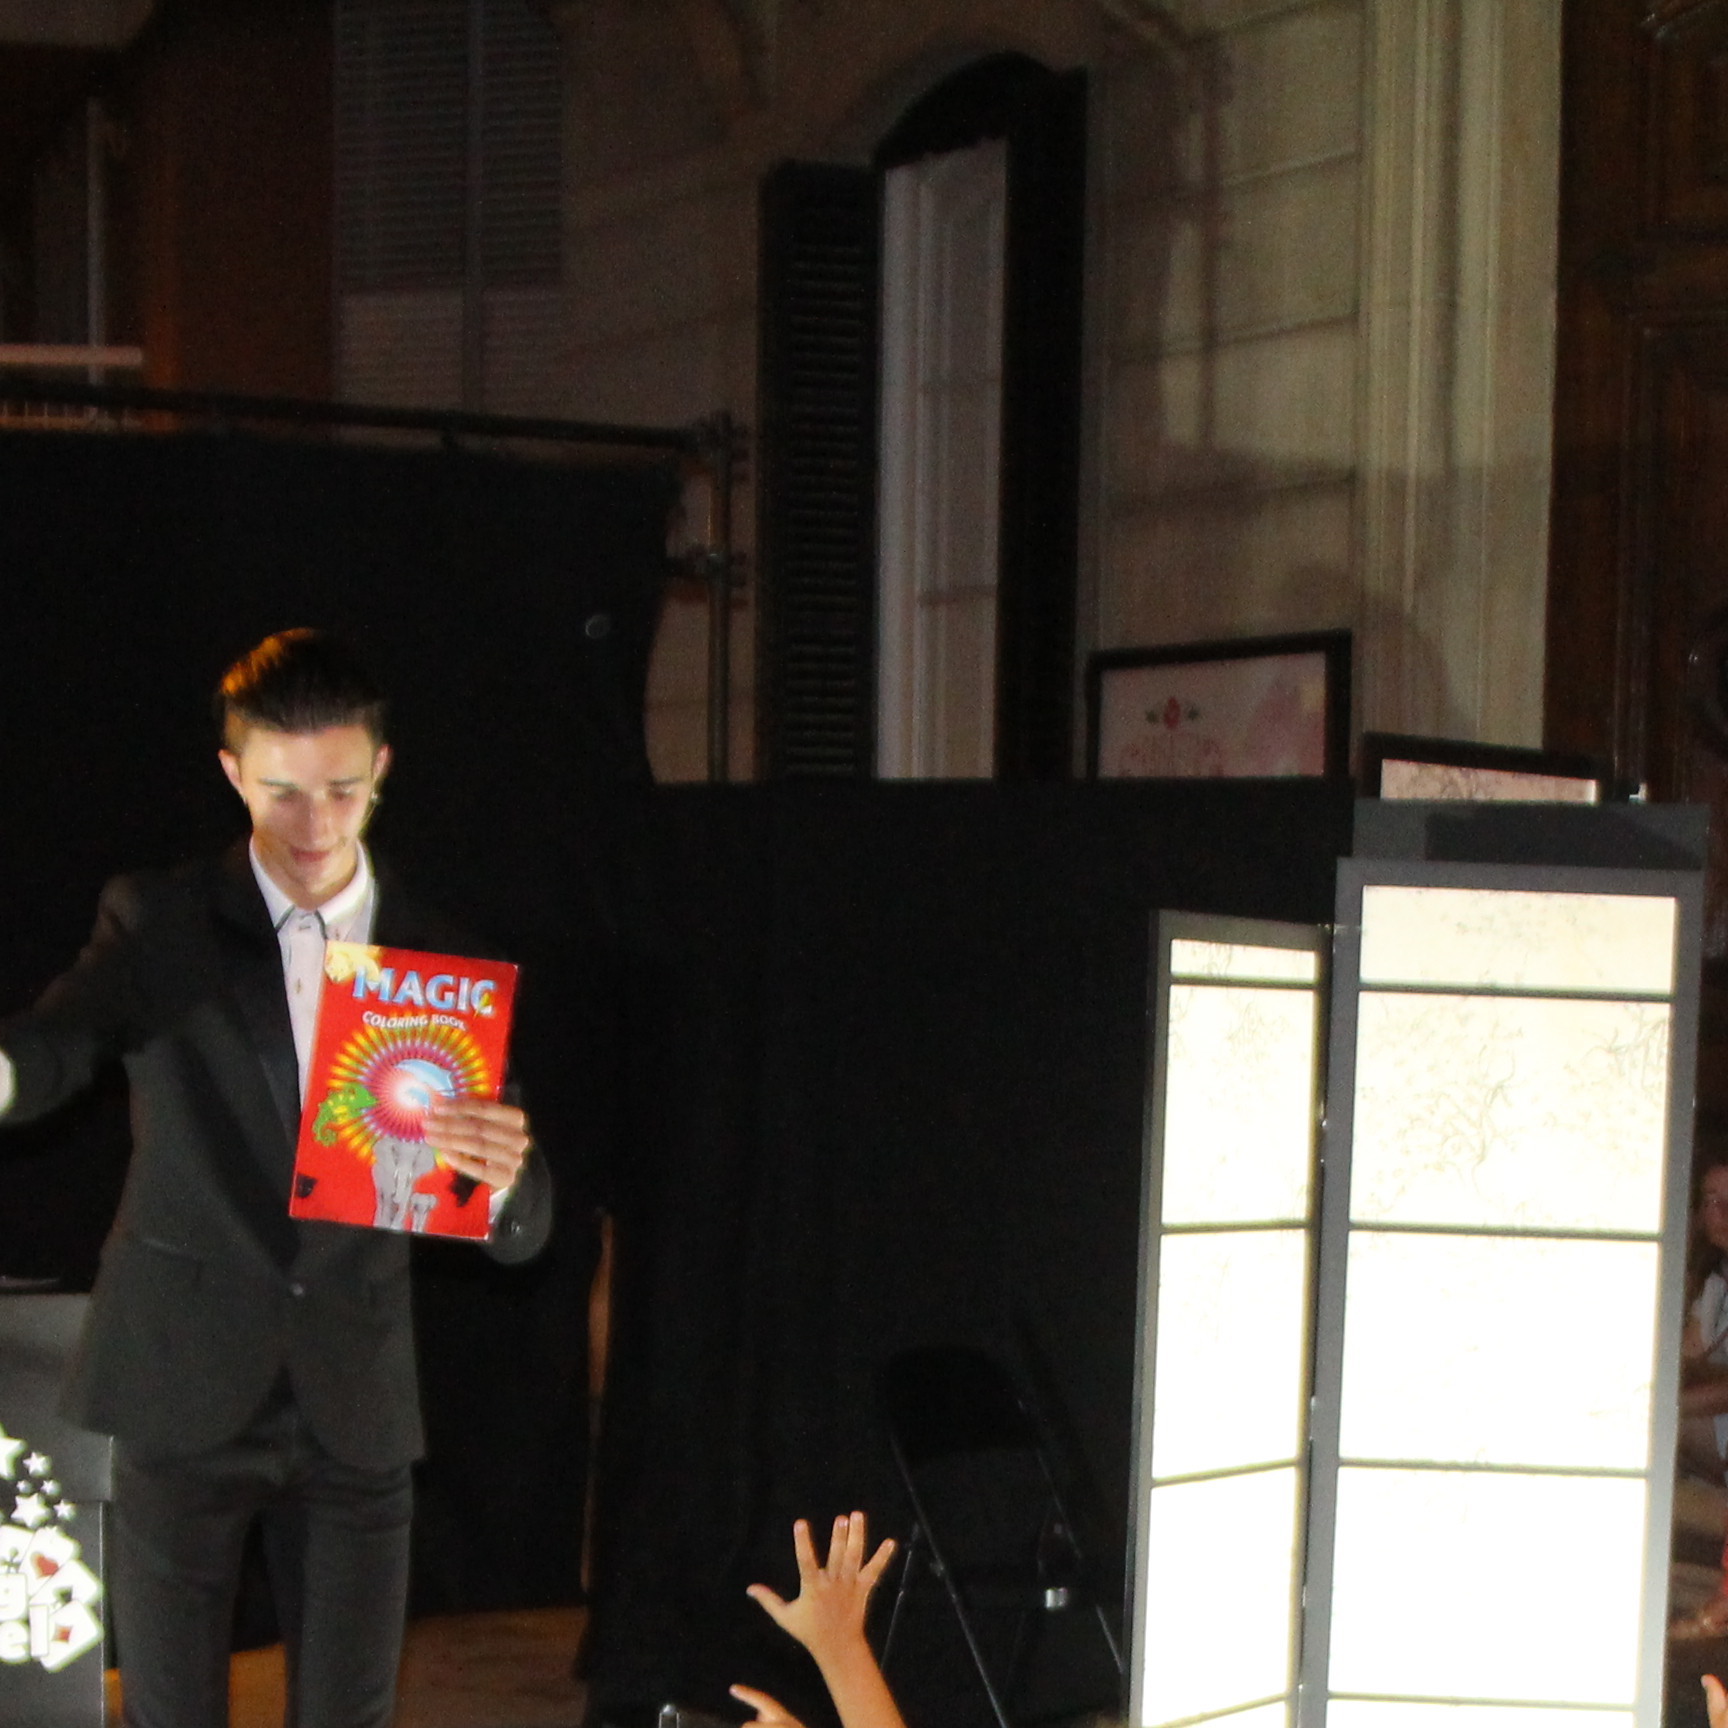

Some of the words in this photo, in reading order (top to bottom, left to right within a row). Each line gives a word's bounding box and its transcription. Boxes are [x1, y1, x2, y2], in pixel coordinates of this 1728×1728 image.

[352, 965, 497, 1017] MAGIC
[362, 1010, 429, 1029] COLORING
[431, 1013, 466, 1032] BOOK
